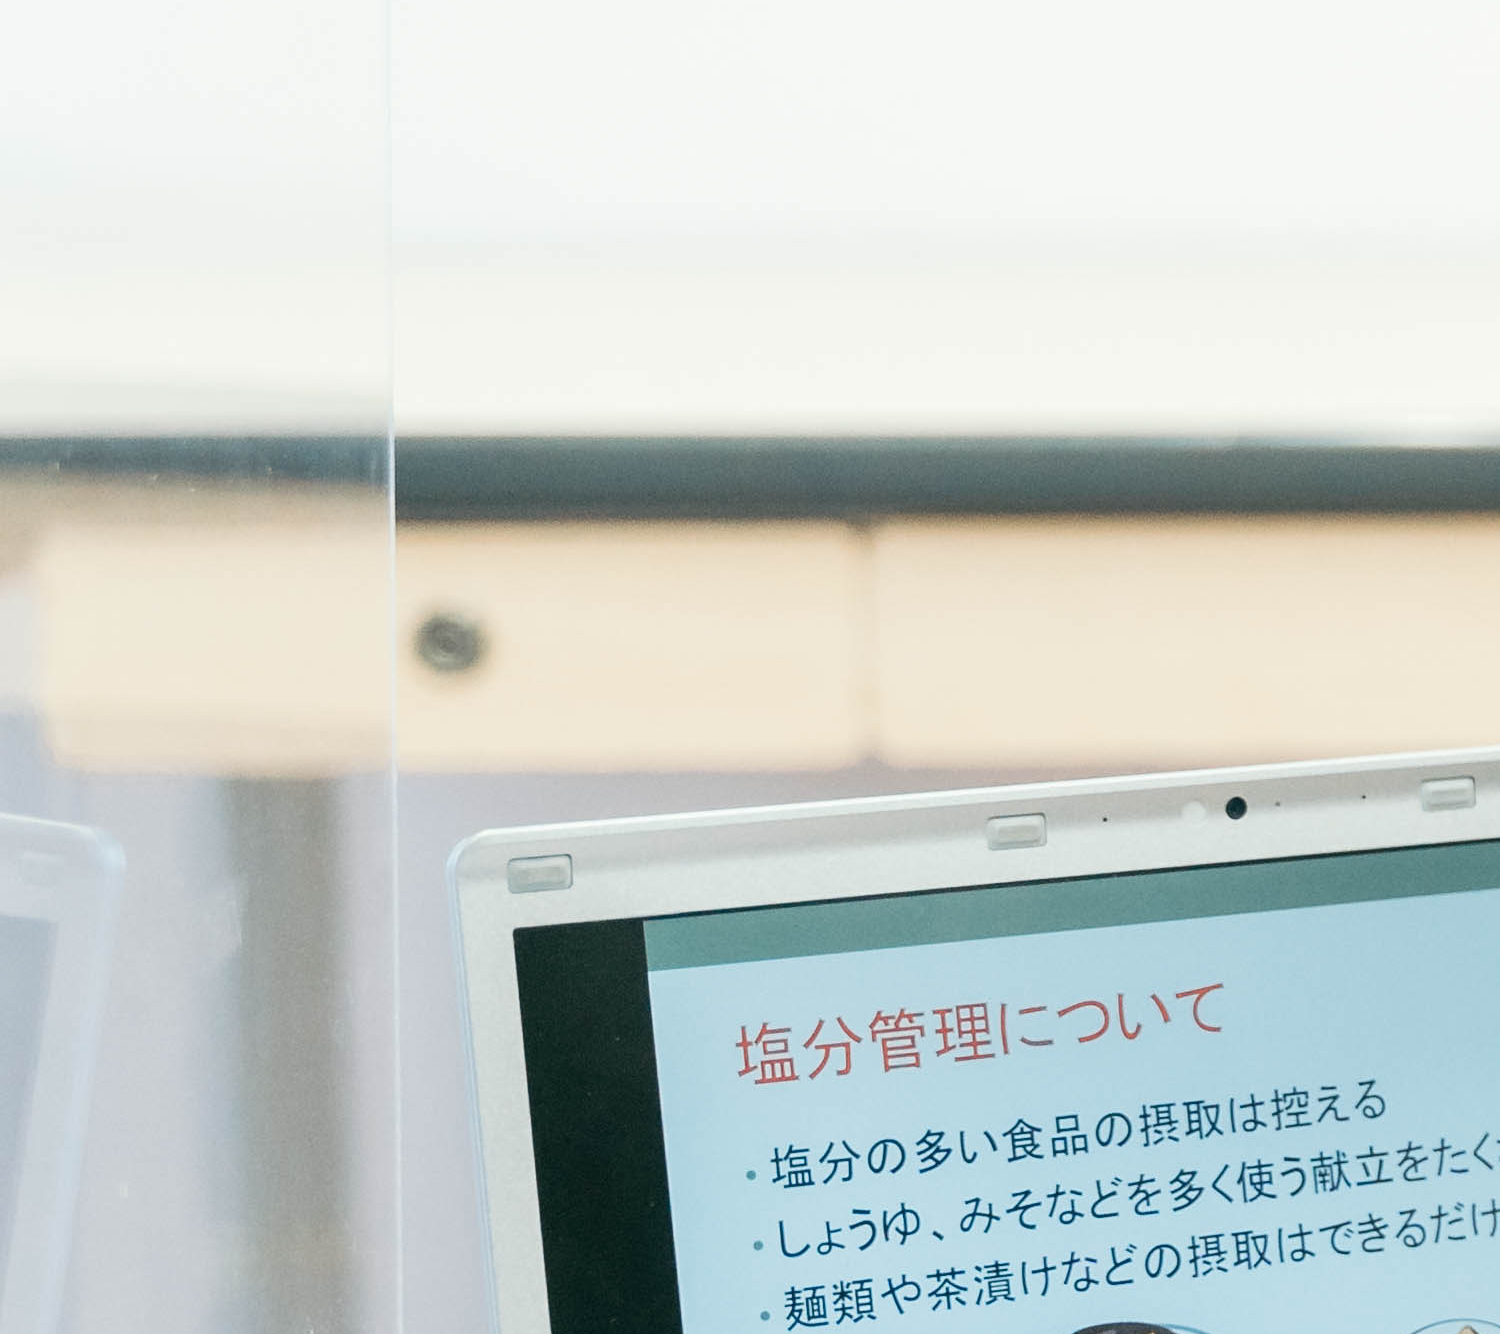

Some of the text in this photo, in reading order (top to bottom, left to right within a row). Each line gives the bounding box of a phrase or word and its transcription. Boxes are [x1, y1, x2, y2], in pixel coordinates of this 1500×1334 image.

[735, 983, 1224, 1085] 塩分管理について
[770, 1079, 1387, 1189] 塩分の多い食品の摂取は控える
